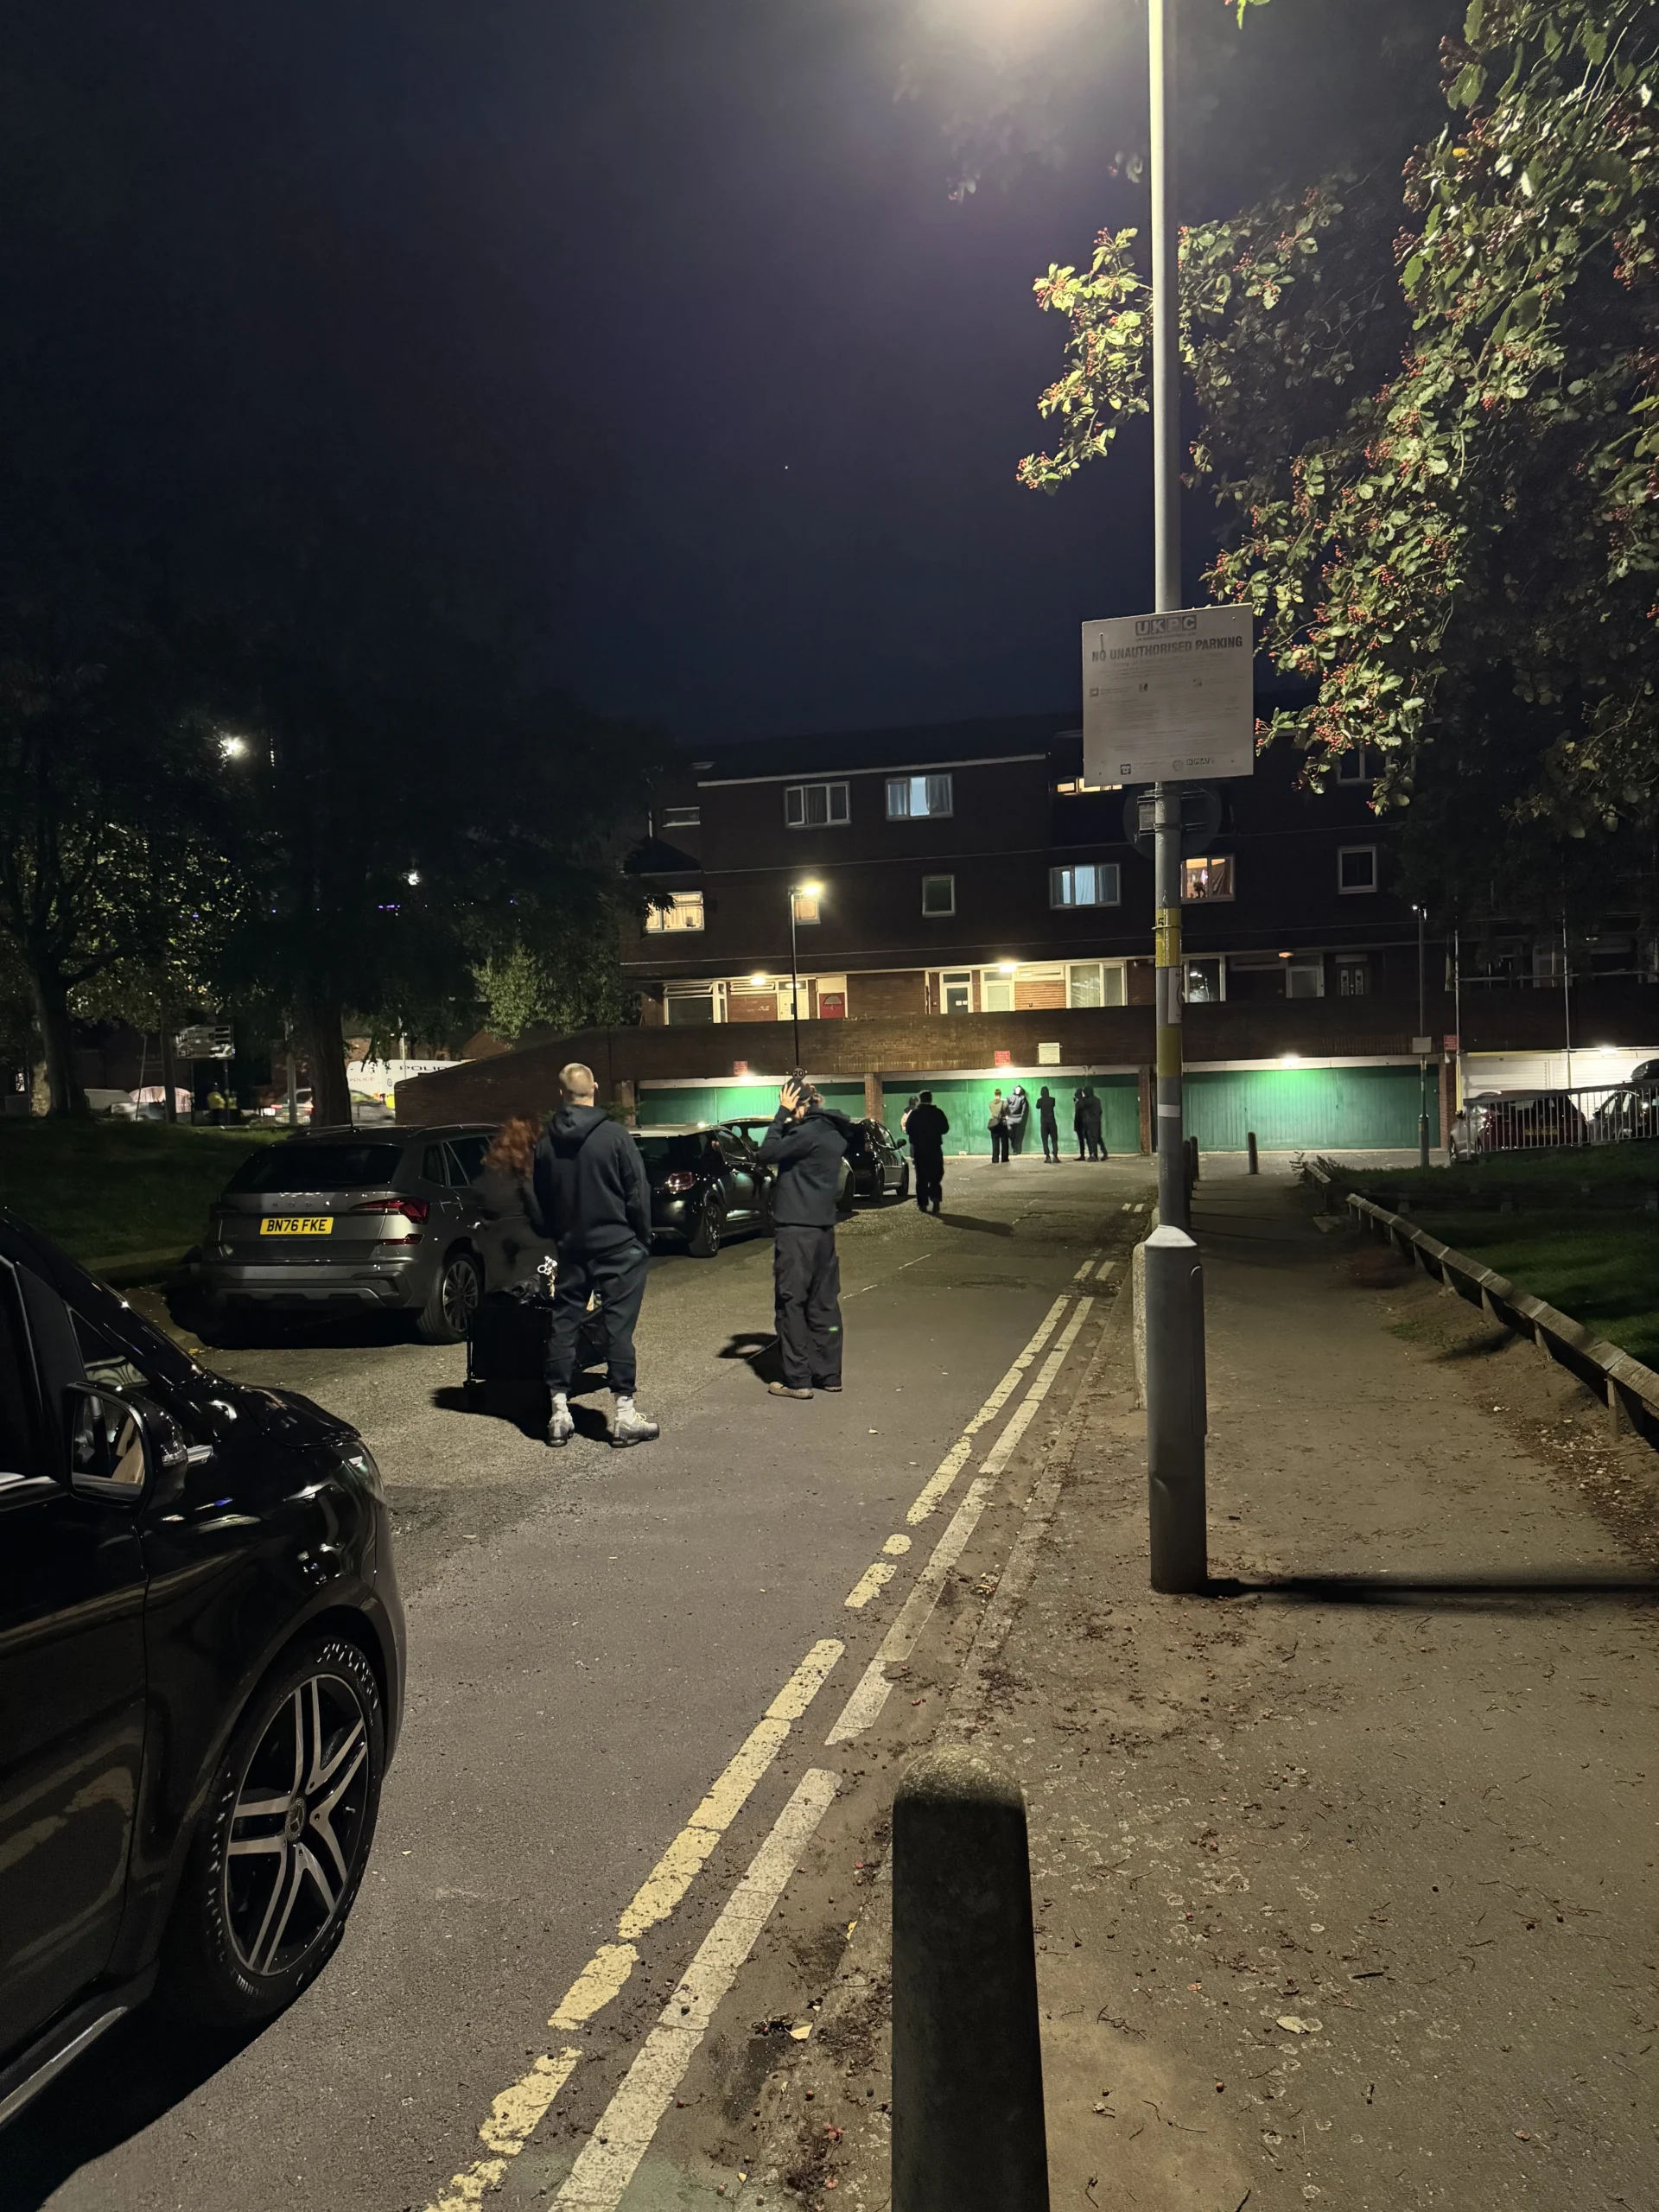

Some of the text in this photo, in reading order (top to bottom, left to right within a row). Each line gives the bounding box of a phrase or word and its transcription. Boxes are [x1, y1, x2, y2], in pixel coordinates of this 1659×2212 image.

[1137, 616, 1196, 635] UKPC
[1092, 650, 1107, 662] NO
[1109, 641, 1192, 660] UNAUTHORISED
[1195, 635, 1243, 651] PARKING
[266, 1218, 327, 1232] BN76 FKE
